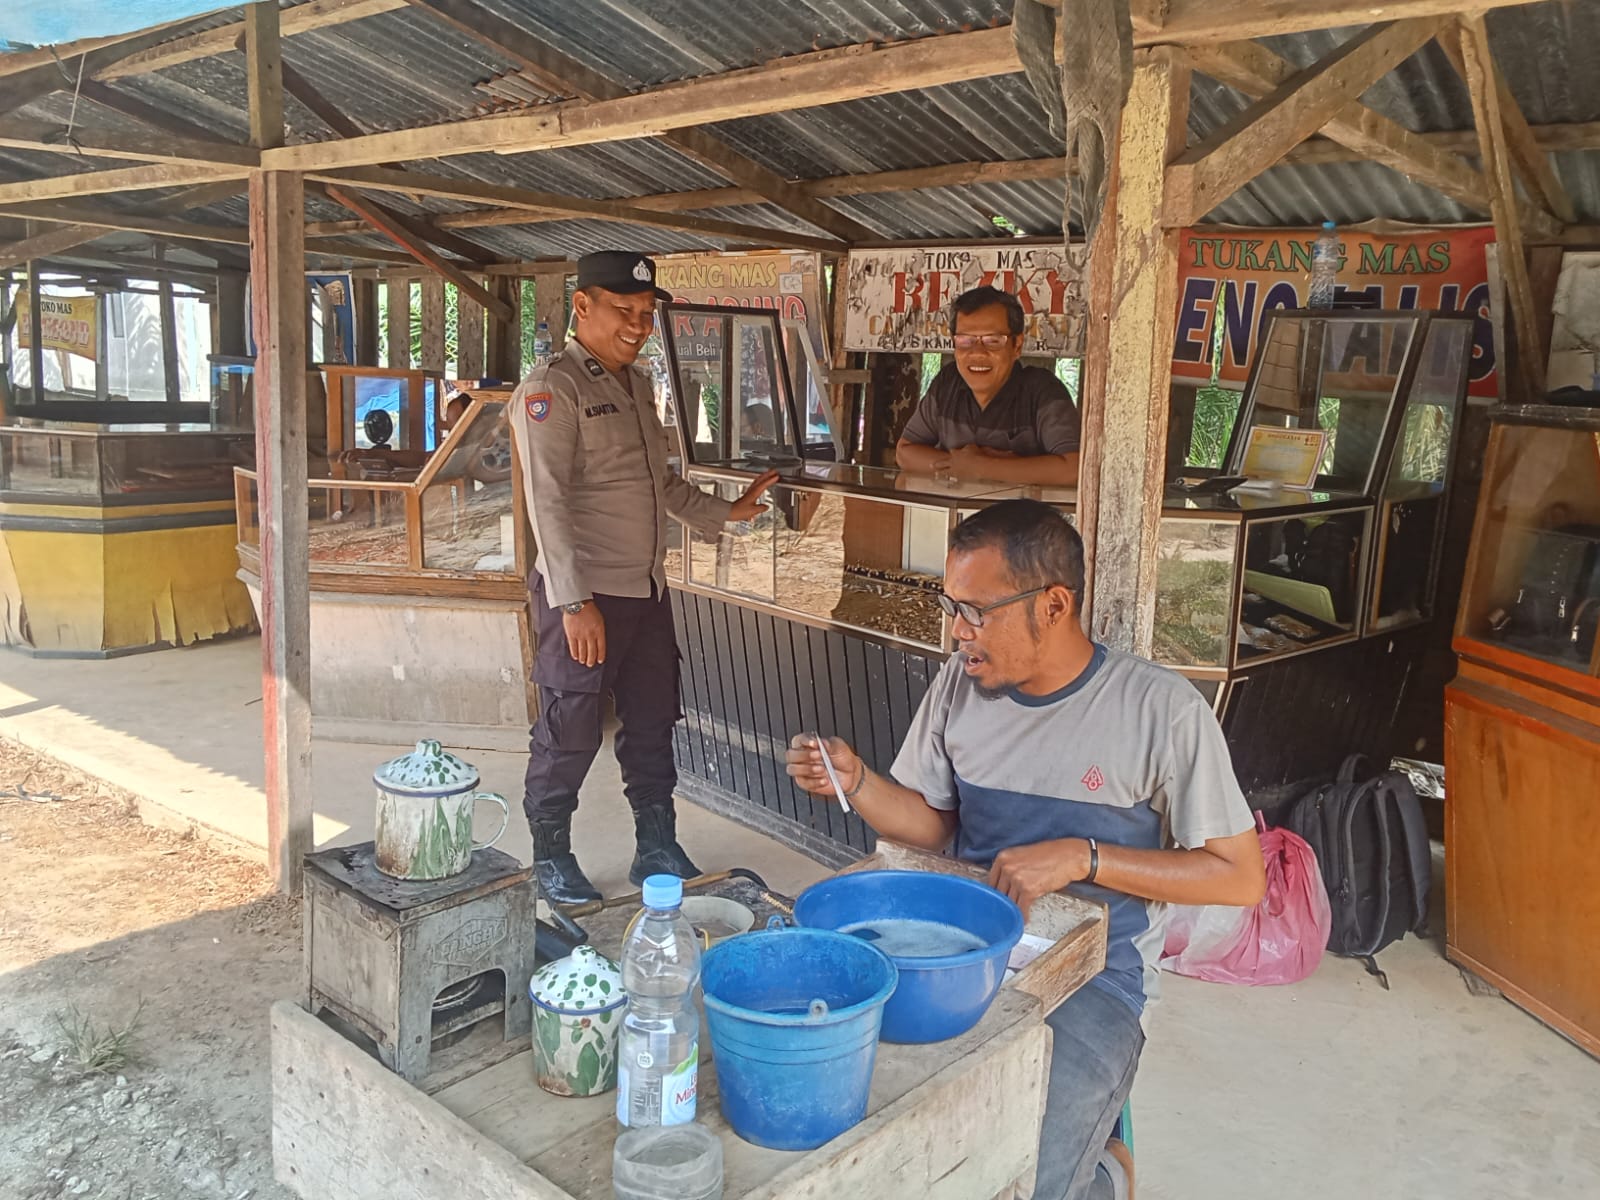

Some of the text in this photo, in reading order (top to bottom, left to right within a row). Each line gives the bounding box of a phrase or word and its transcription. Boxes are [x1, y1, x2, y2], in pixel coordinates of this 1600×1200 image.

[997, 250, 1036, 269] MAS
[1357, 241, 1451, 274] MAS
[729, 262, 777, 289] MAS
[57, 302, 73, 314] MAS
[677, 343, 716, 356] ual Beli
